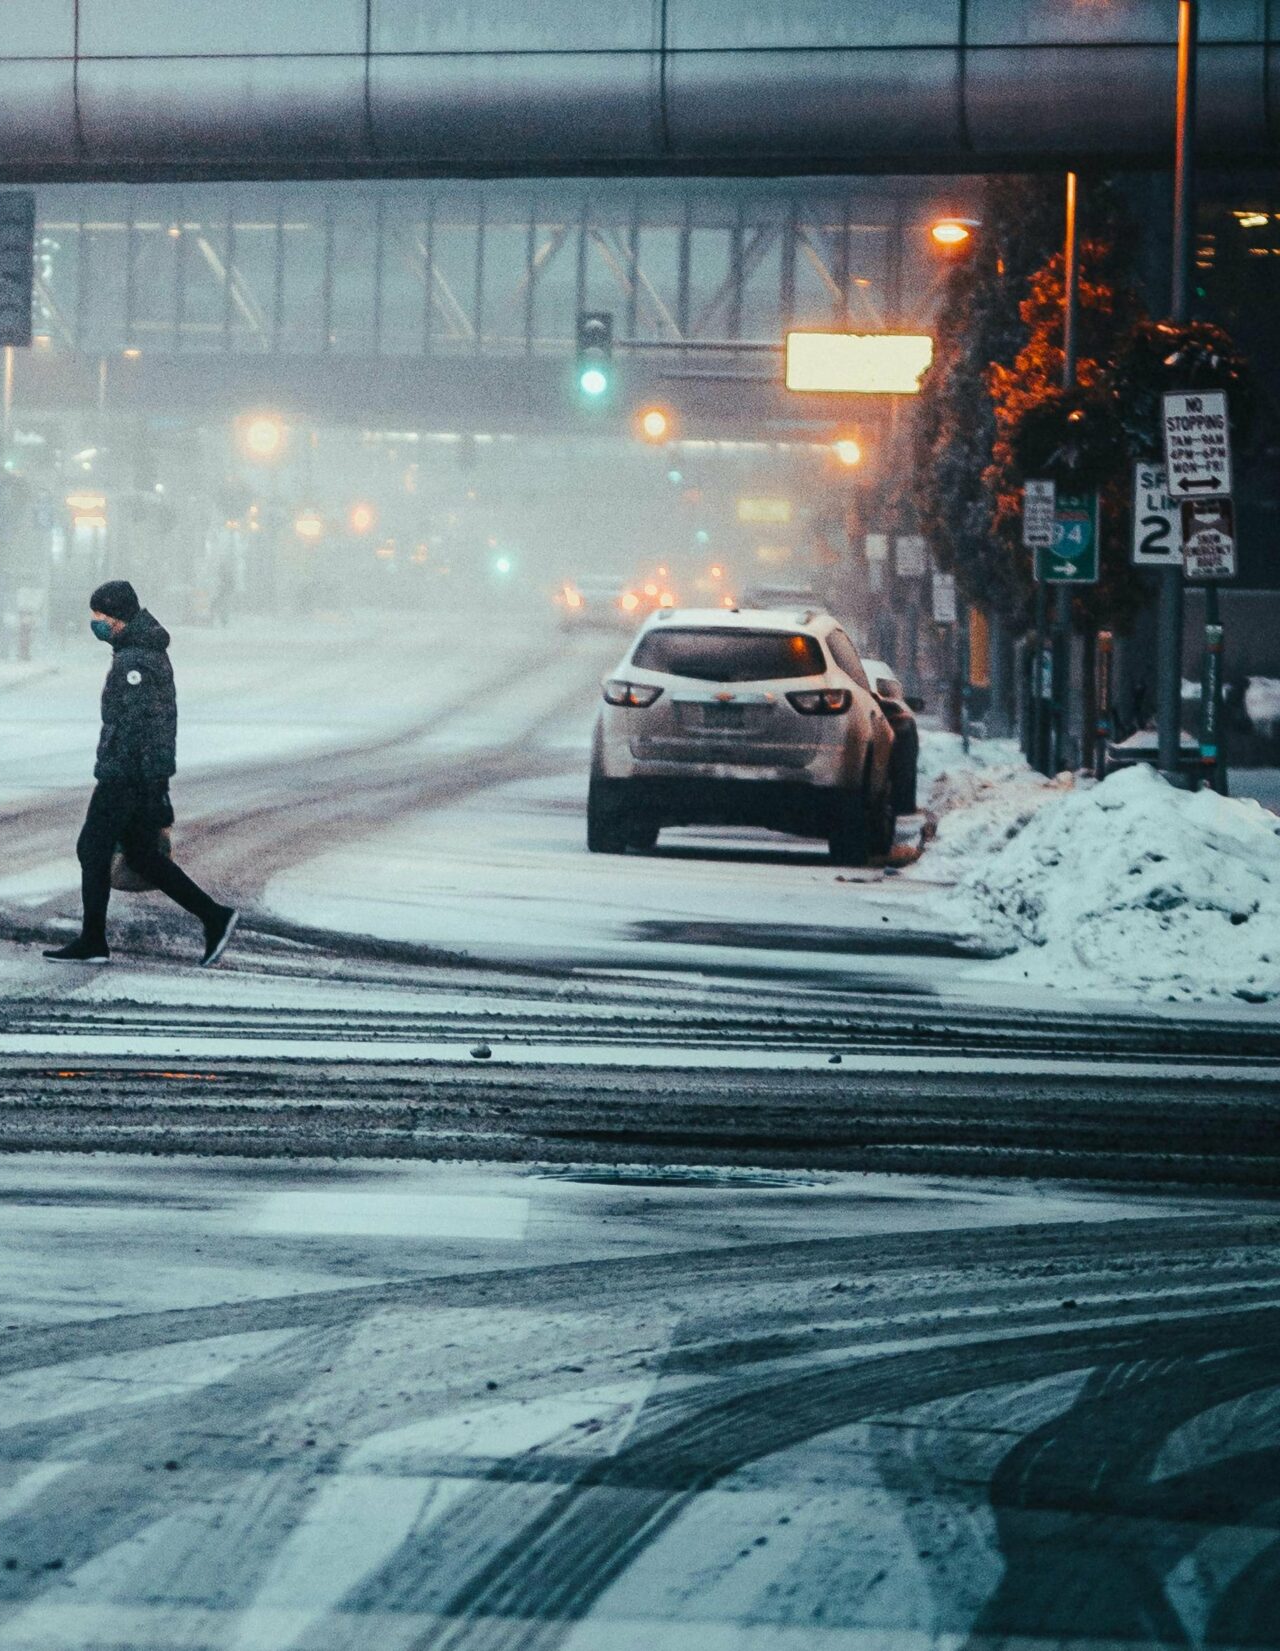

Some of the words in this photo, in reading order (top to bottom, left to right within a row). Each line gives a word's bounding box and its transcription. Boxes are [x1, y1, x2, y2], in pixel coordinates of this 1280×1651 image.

[1185, 397, 1203, 413] NO
[1166, 414, 1224, 432] STOPPING
[1140, 515, 1183, 554] 2
